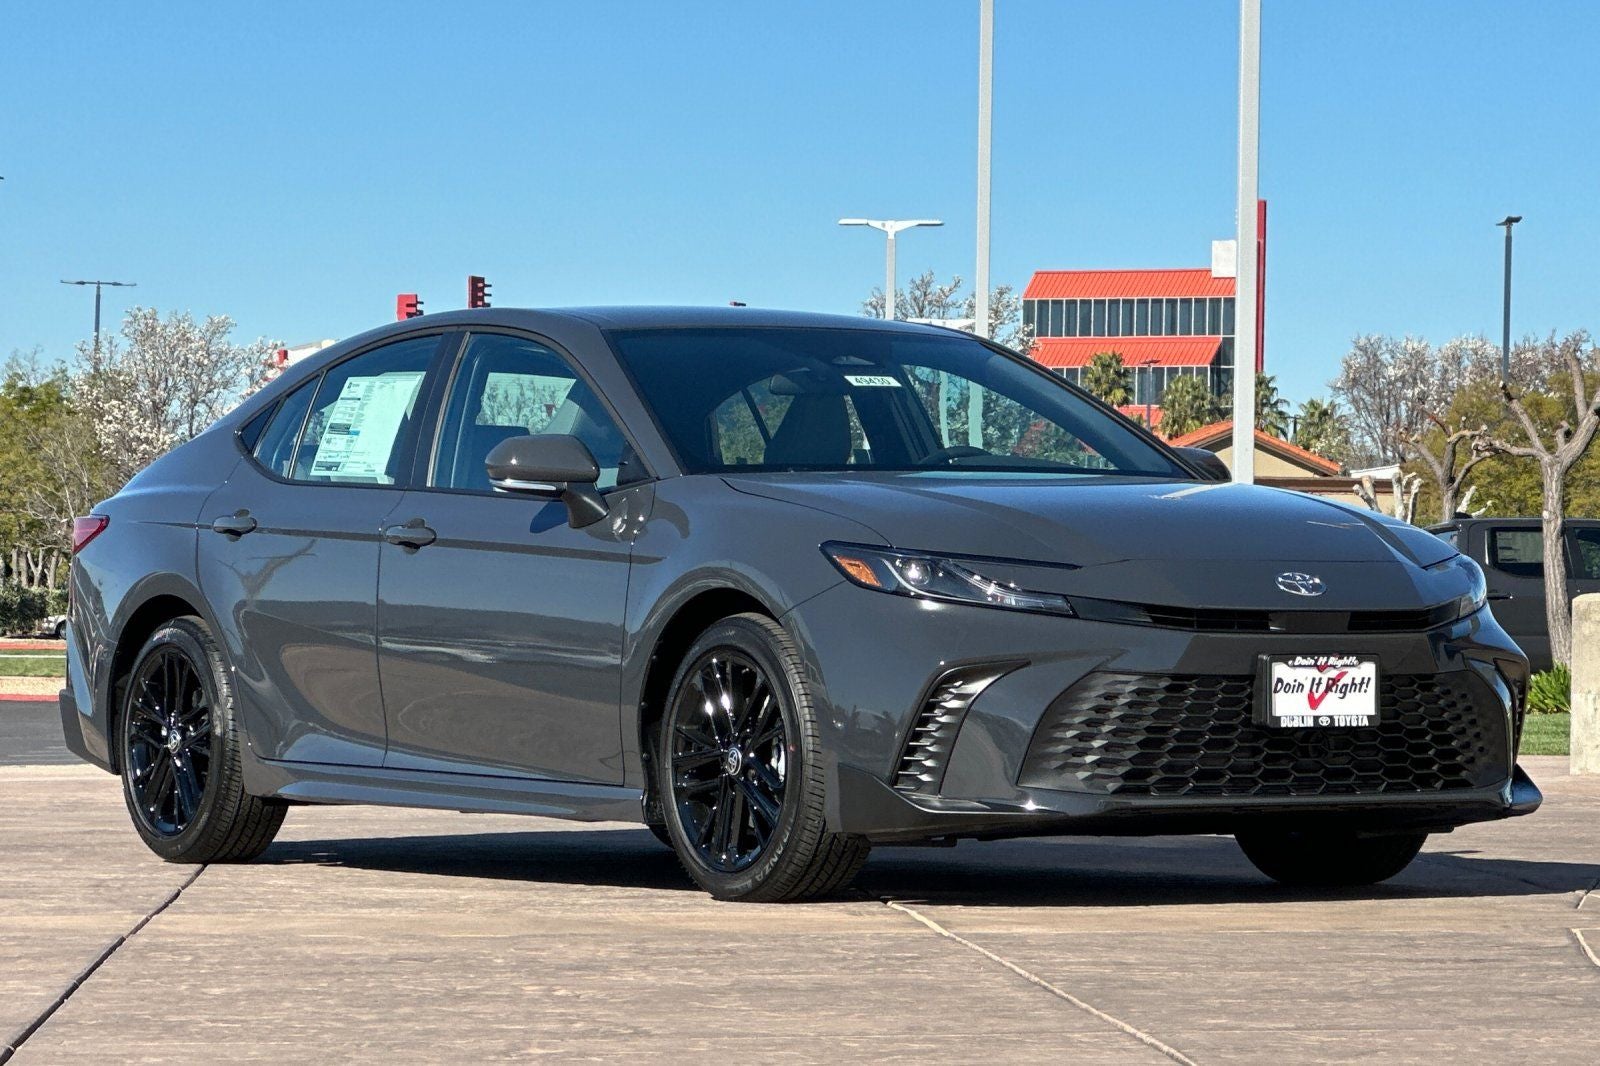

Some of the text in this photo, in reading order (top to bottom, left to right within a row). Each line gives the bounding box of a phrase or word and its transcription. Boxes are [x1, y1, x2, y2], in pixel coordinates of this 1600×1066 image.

[1310, 677, 1323, 694] It
[1325, 677, 1371, 699] Right!
[1334, 715, 1369, 727] TOYOTA
